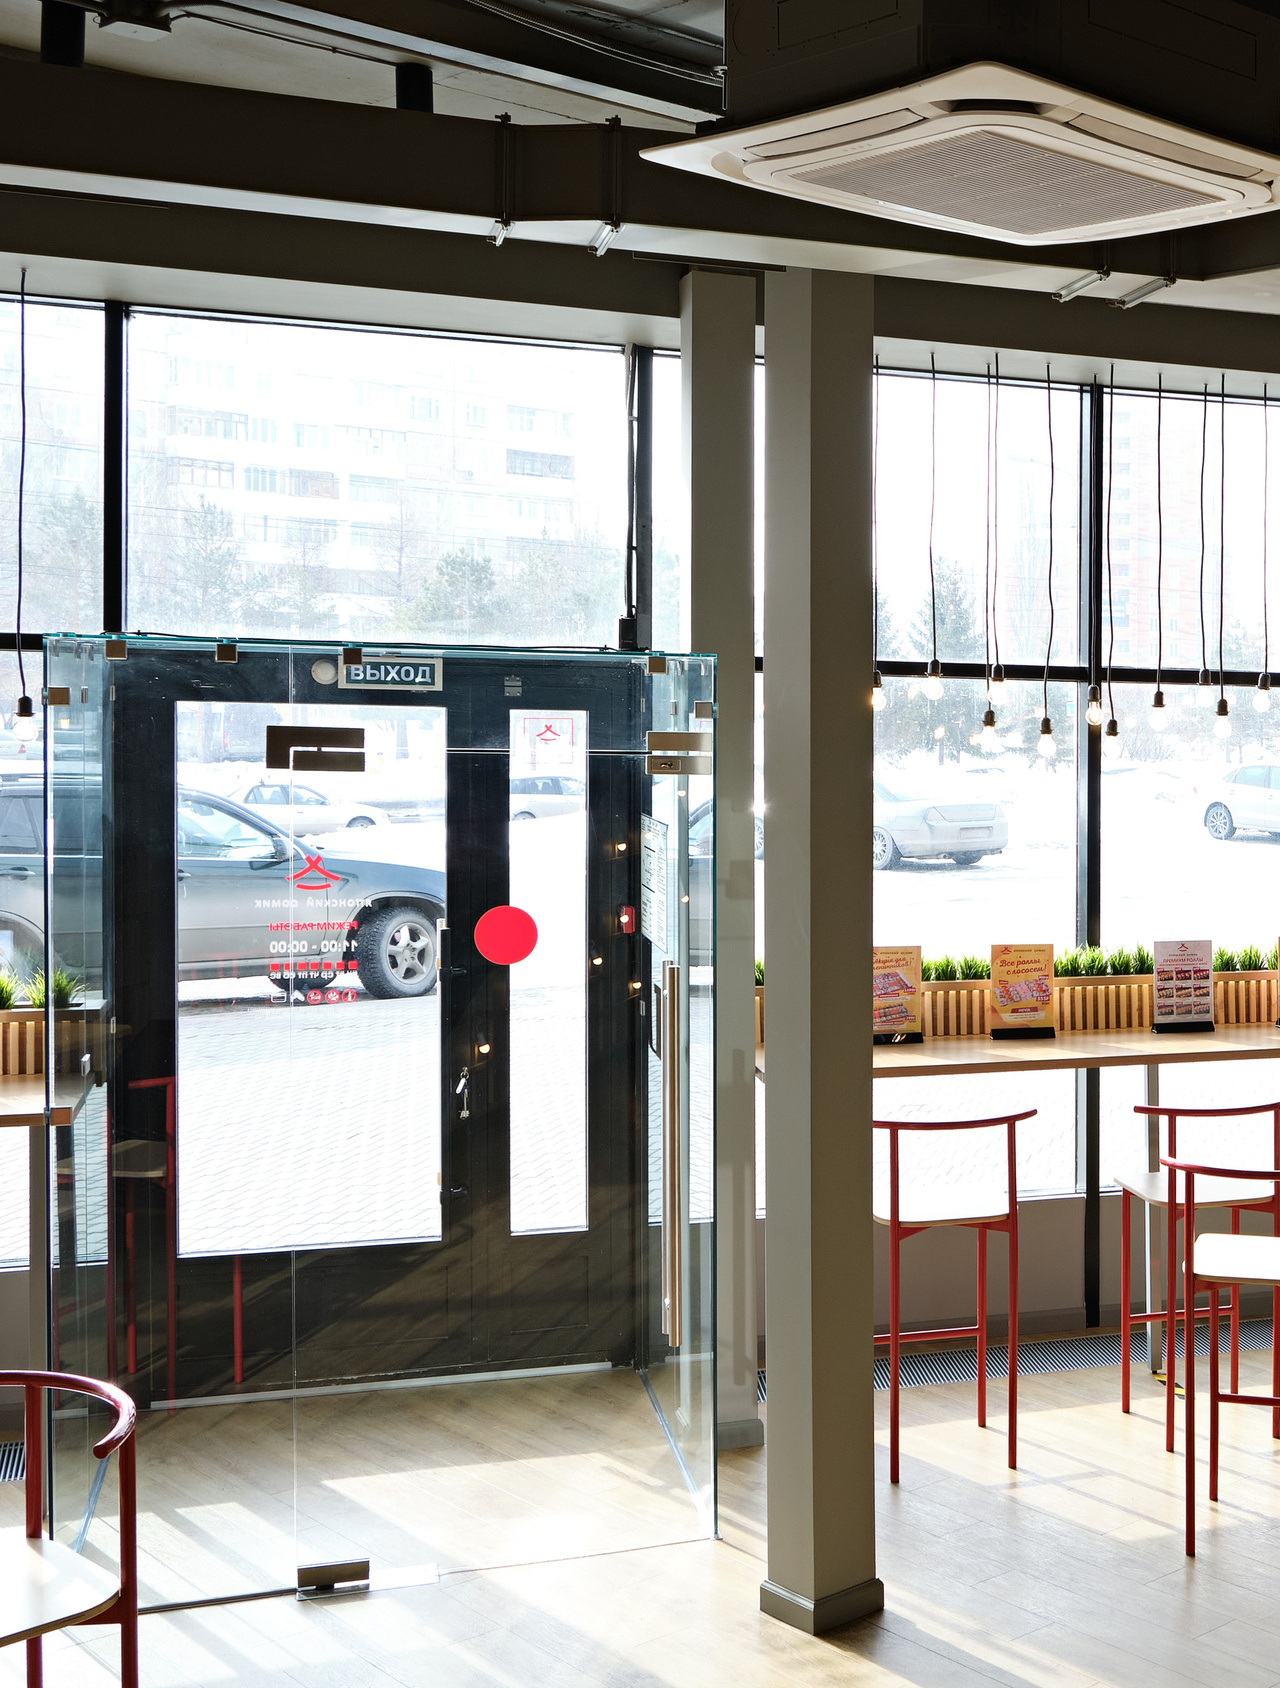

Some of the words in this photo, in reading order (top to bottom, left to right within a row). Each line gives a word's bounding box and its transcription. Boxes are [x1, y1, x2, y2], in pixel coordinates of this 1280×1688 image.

[350, 664, 431, 683] ВЫХОД
[999, 958, 1015, 968] Все
[1016, 957, 1041, 968] роллы
[1012, 963, 1047, 975] лососем!
